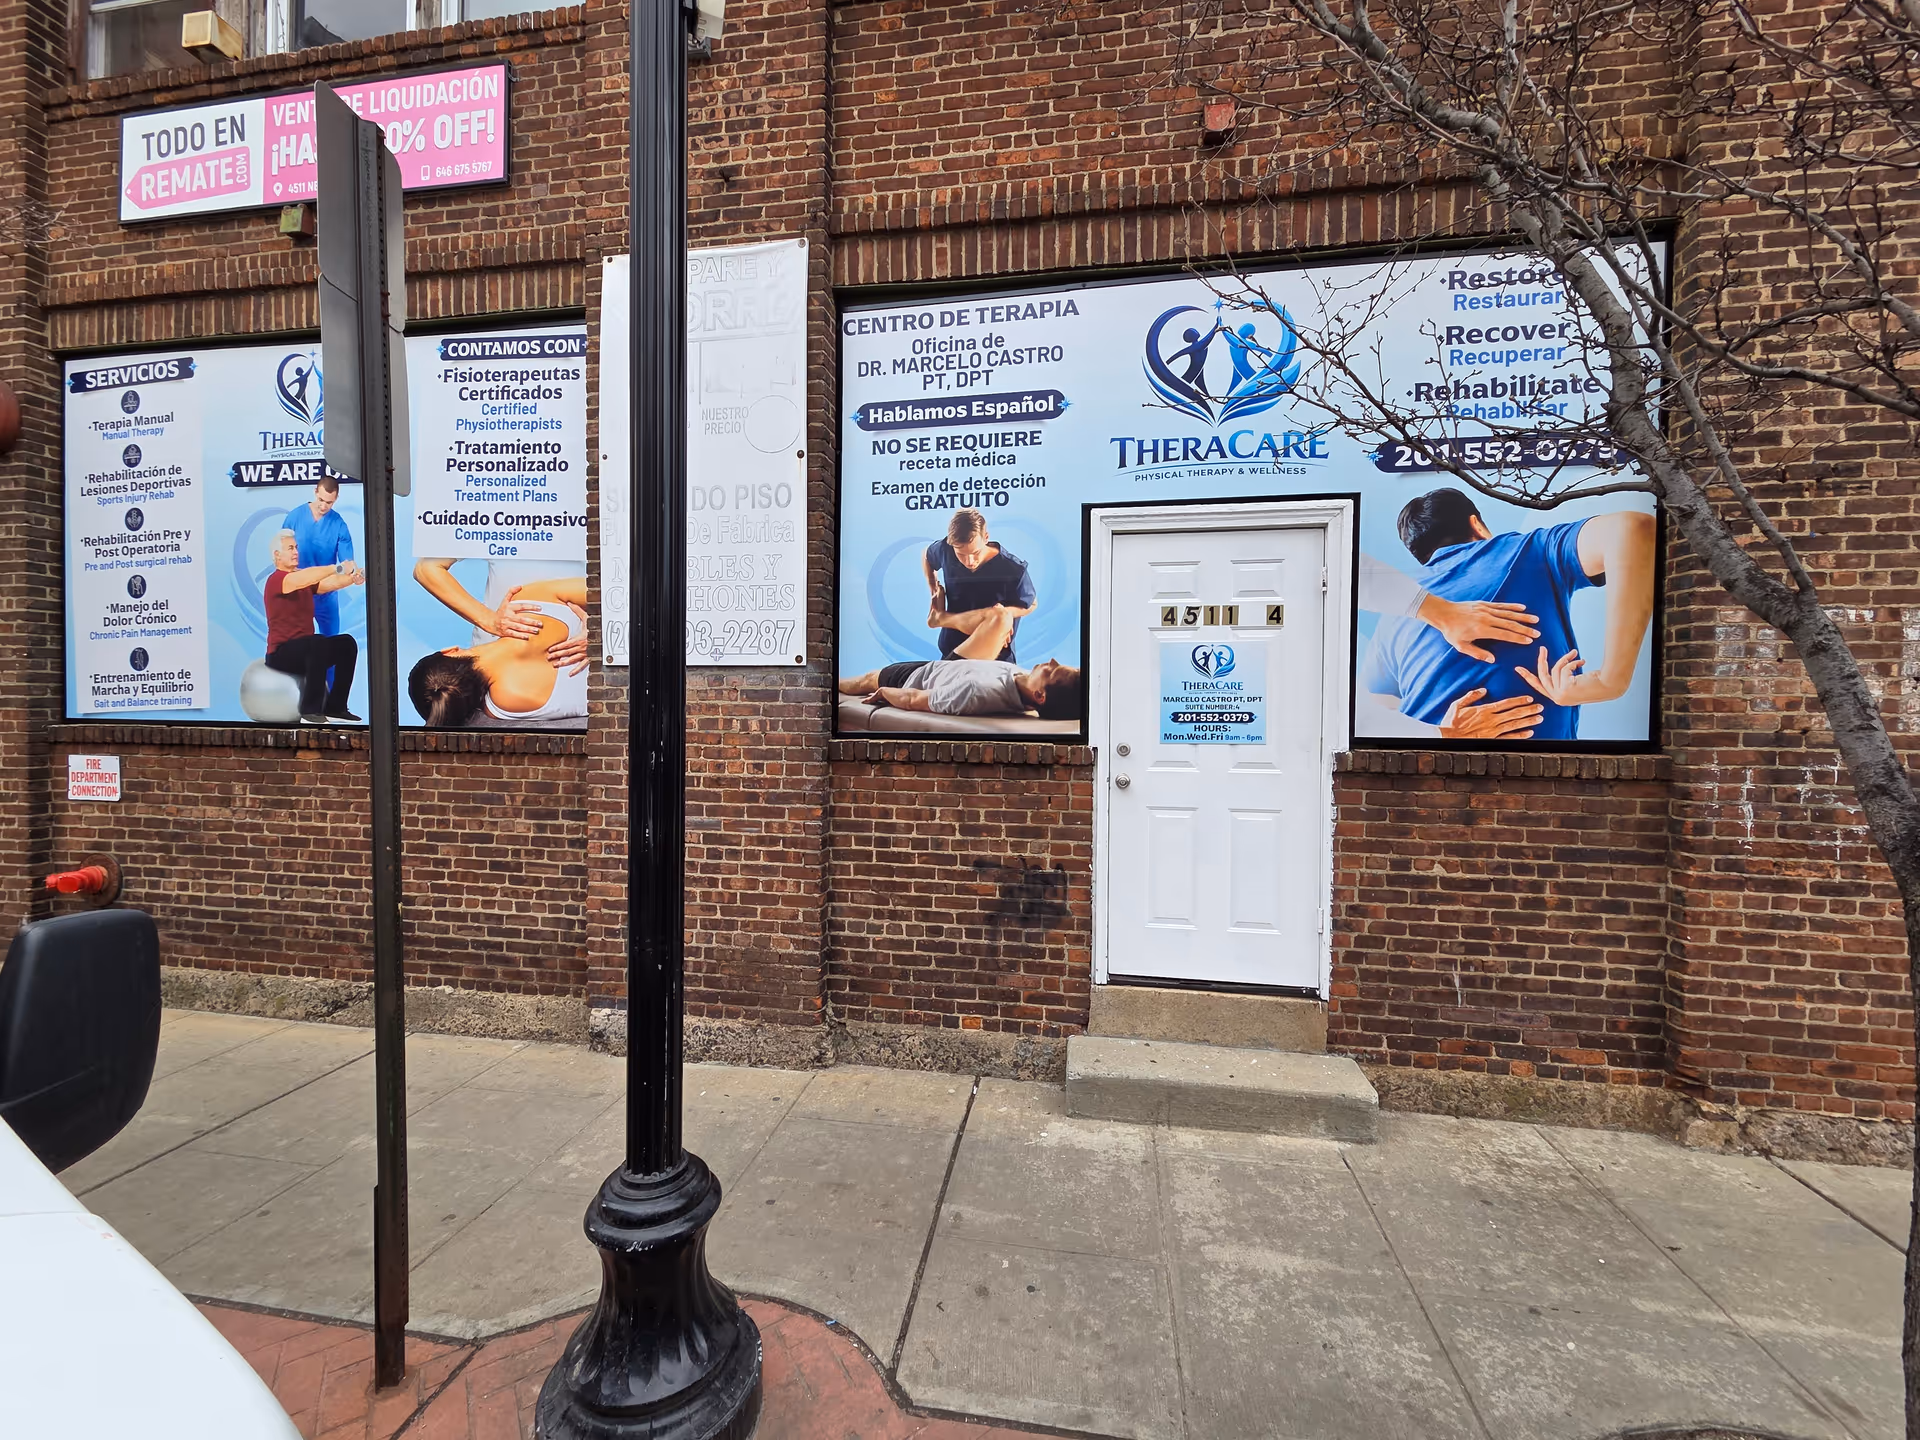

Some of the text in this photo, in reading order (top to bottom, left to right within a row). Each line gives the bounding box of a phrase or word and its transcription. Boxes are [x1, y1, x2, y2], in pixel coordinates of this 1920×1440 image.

[370, 71, 498, 114] LIQUIDACIÓN
[142, 114, 245, 160] TODO EN
[434, 109, 495, 149] OFF!
[236, 154, 248, 185] .COM
[436, 160, 492, 178] 646 675 5767
[142, 157, 233, 201] REMATE
[288, 183, 305, 193] 4511
[1454, 291, 1564, 311] Restaurar
[843, 299, 1079, 336] CENTRO DE TERAPIA
[1446, 323, 1571, 345] Recover
[447, 339, 580, 357] CONTAMOS CON
[912, 333, 1005, 354] Oficina de
[858, 345, 1063, 377] DR. MARCELO CASTRO
[1450, 347, 1565, 367] Recuperar
[85, 361, 179, 389] SERVICIOS
[443, 367, 580, 385] Fisioterapeutas
[923, 370, 993, 390] PT, DPT
[459, 385, 563, 401] Certificados
[1414, 374, 1601, 402] Rehabilitate
[481, 403, 537, 415] Certified
[702, 407, 749, 421] NUESTRO
[869, 395, 1054, 423] Hablamos Español
[1446, 401, 1568, 421] Rehabilitar
[93, 412, 174, 431] Terapia Manual
[456, 418, 562, 433] Physiotherapists
[704, 423, 741, 434] PRECIO
[102, 427, 164, 440] Manual Therapy
[872, 430, 1042, 455] NO SE REQUIERE
[455, 439, 561, 455] Tratamiento
[446, 457, 569, 472] Personalizado
[900, 452, 1016, 471] receta médica
[89, 465, 182, 484] Rehabilitación de
[240, 464, 273, 482] WE
[278, 462, 321, 481] ARE
[466, 475, 546, 486] Personalized
[1135, 470, 1184, 482] PHYSICAL
[1187, 468, 1234, 477] THERAPY
[1249, 467, 1307, 475] WELLNESS
[81, 477, 191, 496] Lesiones Deportivas
[872, 474, 1046, 495] Examen de detección
[97, 490, 174, 506] Sports Injury Rehab
[454, 490, 557, 502] Treatment Plans
[735, 483, 792, 509] PISO
[905, 491, 1009, 510] GRATUITO
[422, 510, 587, 530] Cuidado Compasivo
[718, 514, 794, 543] Fábrica
[84, 530, 190, 547] Rehabilitación Pre y
[455, 528, 553, 542] Compassionate
[95, 542, 180, 559] Post Operatoria
[489, 544, 517, 555] Care
[85, 555, 192, 571] Pre and Post surgical rehab
[762, 554, 782, 580] Y
[110, 600, 168, 615] Manejo del
[1163, 605, 1281, 625] 4511 4
[104, 612, 176, 627] Dolor Crónico
[90, 626, 192, 640] Chronic Pain Management
[94, 670, 191, 684] Entrenamiento de
[92, 681, 194, 697] Marcha y Equilibrio
[94, 696, 192, 708] Gait and Balance training
[86, 759, 101, 769] FIRE
[71, 772, 117, 783] DEPARTMENT
[72, 785, 118, 796] CONNECTION
